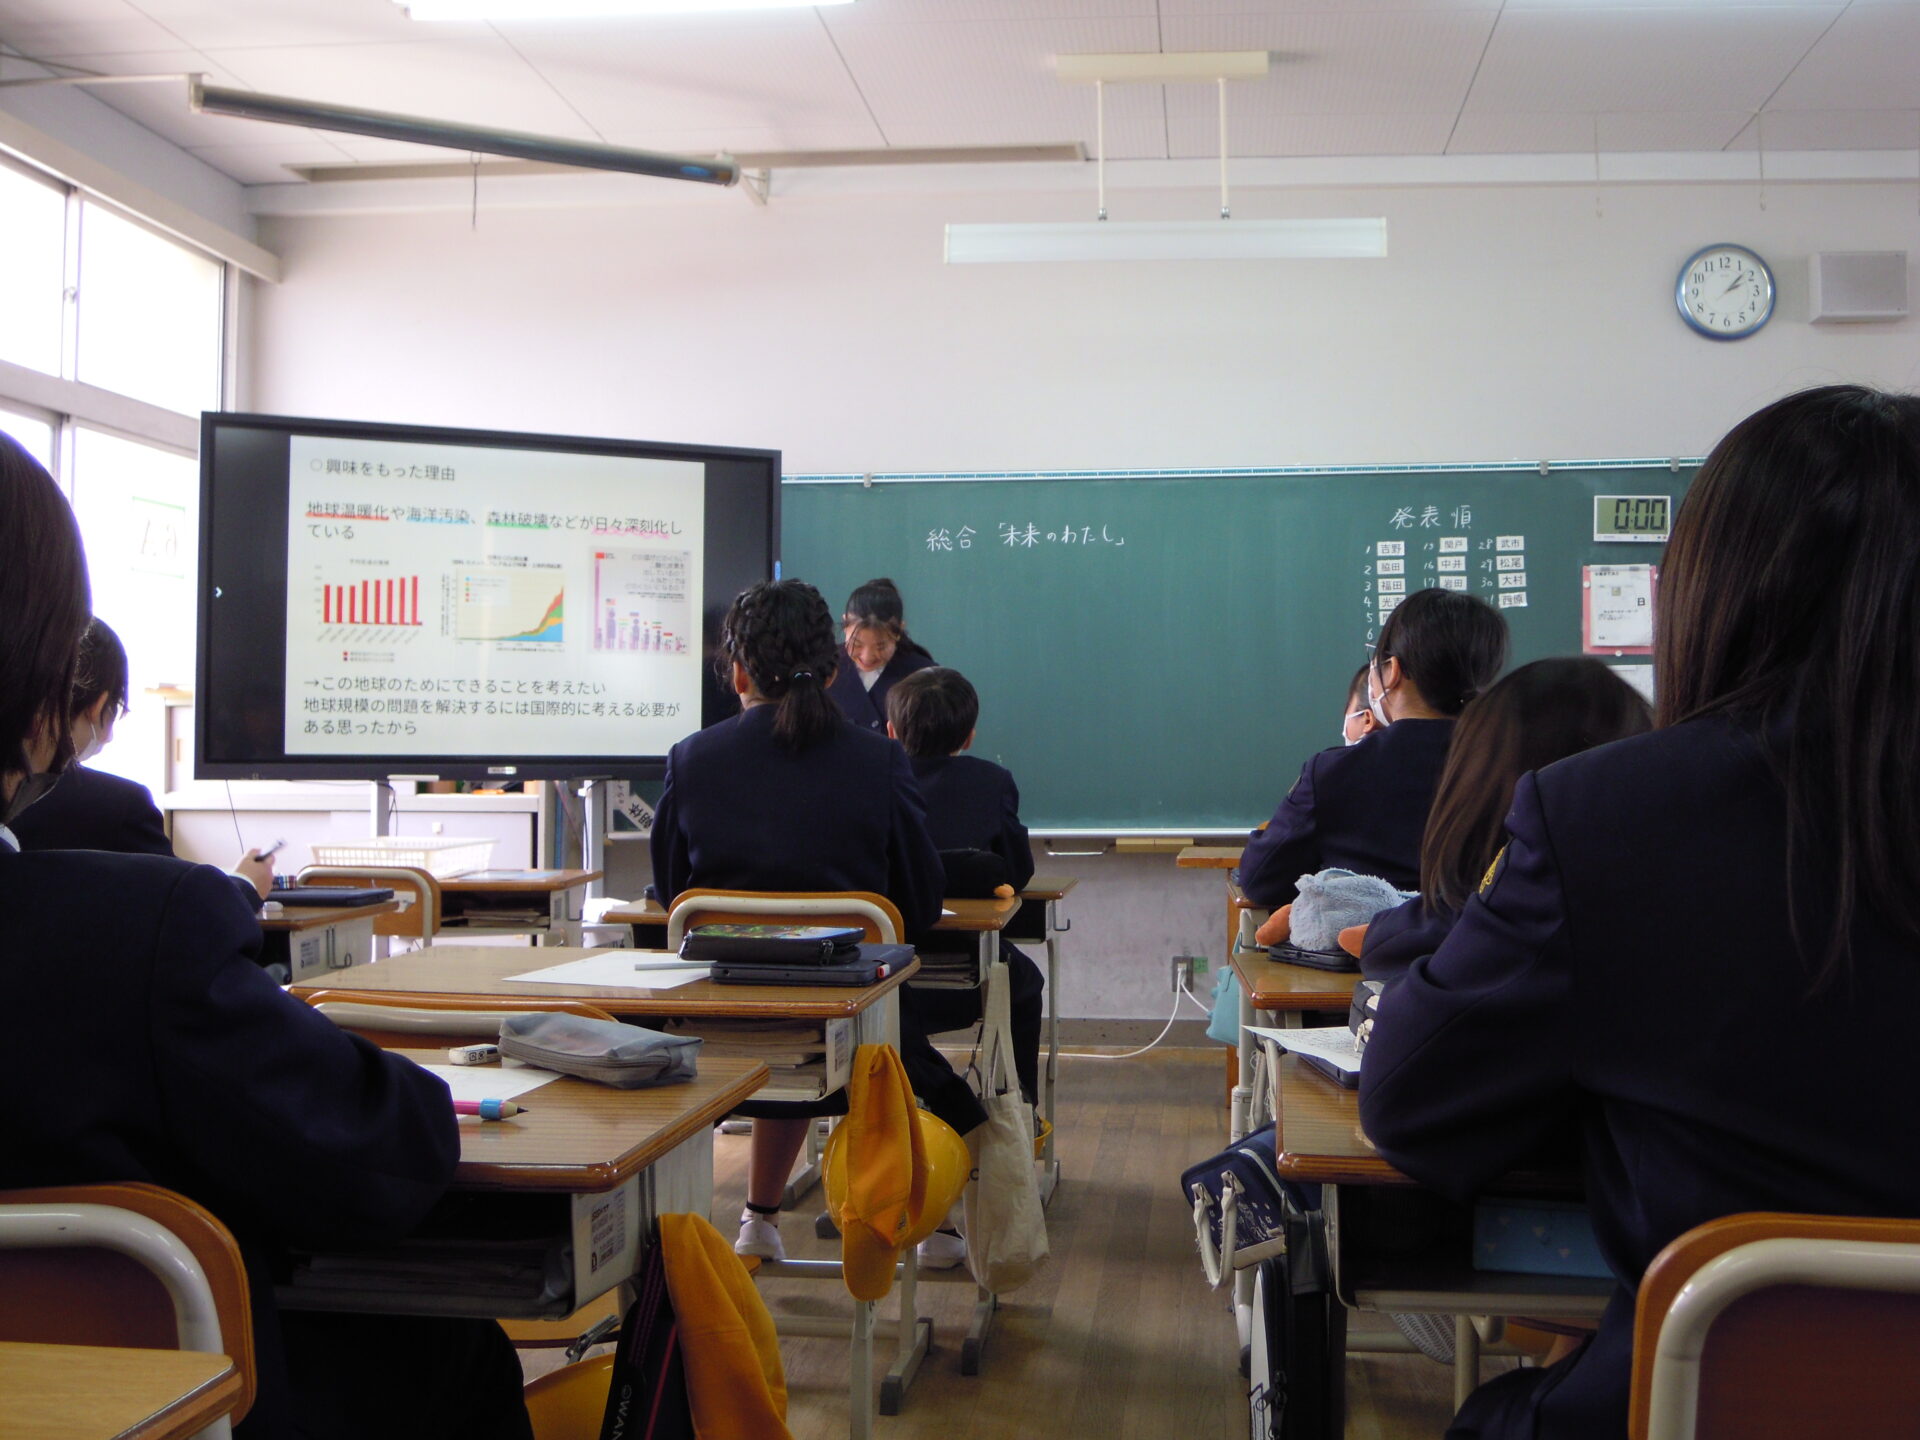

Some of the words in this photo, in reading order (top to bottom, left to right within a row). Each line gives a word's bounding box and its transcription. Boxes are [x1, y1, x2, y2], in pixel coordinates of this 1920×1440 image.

[1704, 260, 1714, 272] 11
[1719, 256, 1731, 269] 12
[1738, 259, 1742, 271] 1
[1694, 272, 1705, 284] 10
[1748, 269, 1755, 282] 2
[1691, 287, 1699, 299] 9
[1753, 284, 1760, 297] 3
[1697, 303, 1705, 313] 8
[1749, 300, 1756, 313] 4
[1709, 312, 1716, 325] 7
[1723, 316, 1731, 328] 6
[1738, 311, 1746, 324] 5
[1614, 498, 1668, 530] 0:00
[307, 524, 354, 540] ている
[926, 525, 977, 552] 総合
[1364, 565, 1371, 575] 2
[1441, 560, 1462, 569] 中井
[1480, 559, 1493, 573] 29
[1364, 581, 1371, 592] 3
[1363, 597, 1372, 608] 4
[1366, 612, 1373, 623] 5
[1367, 628, 1374, 640] 6
[304, 719, 417, 735] ある思ったから
